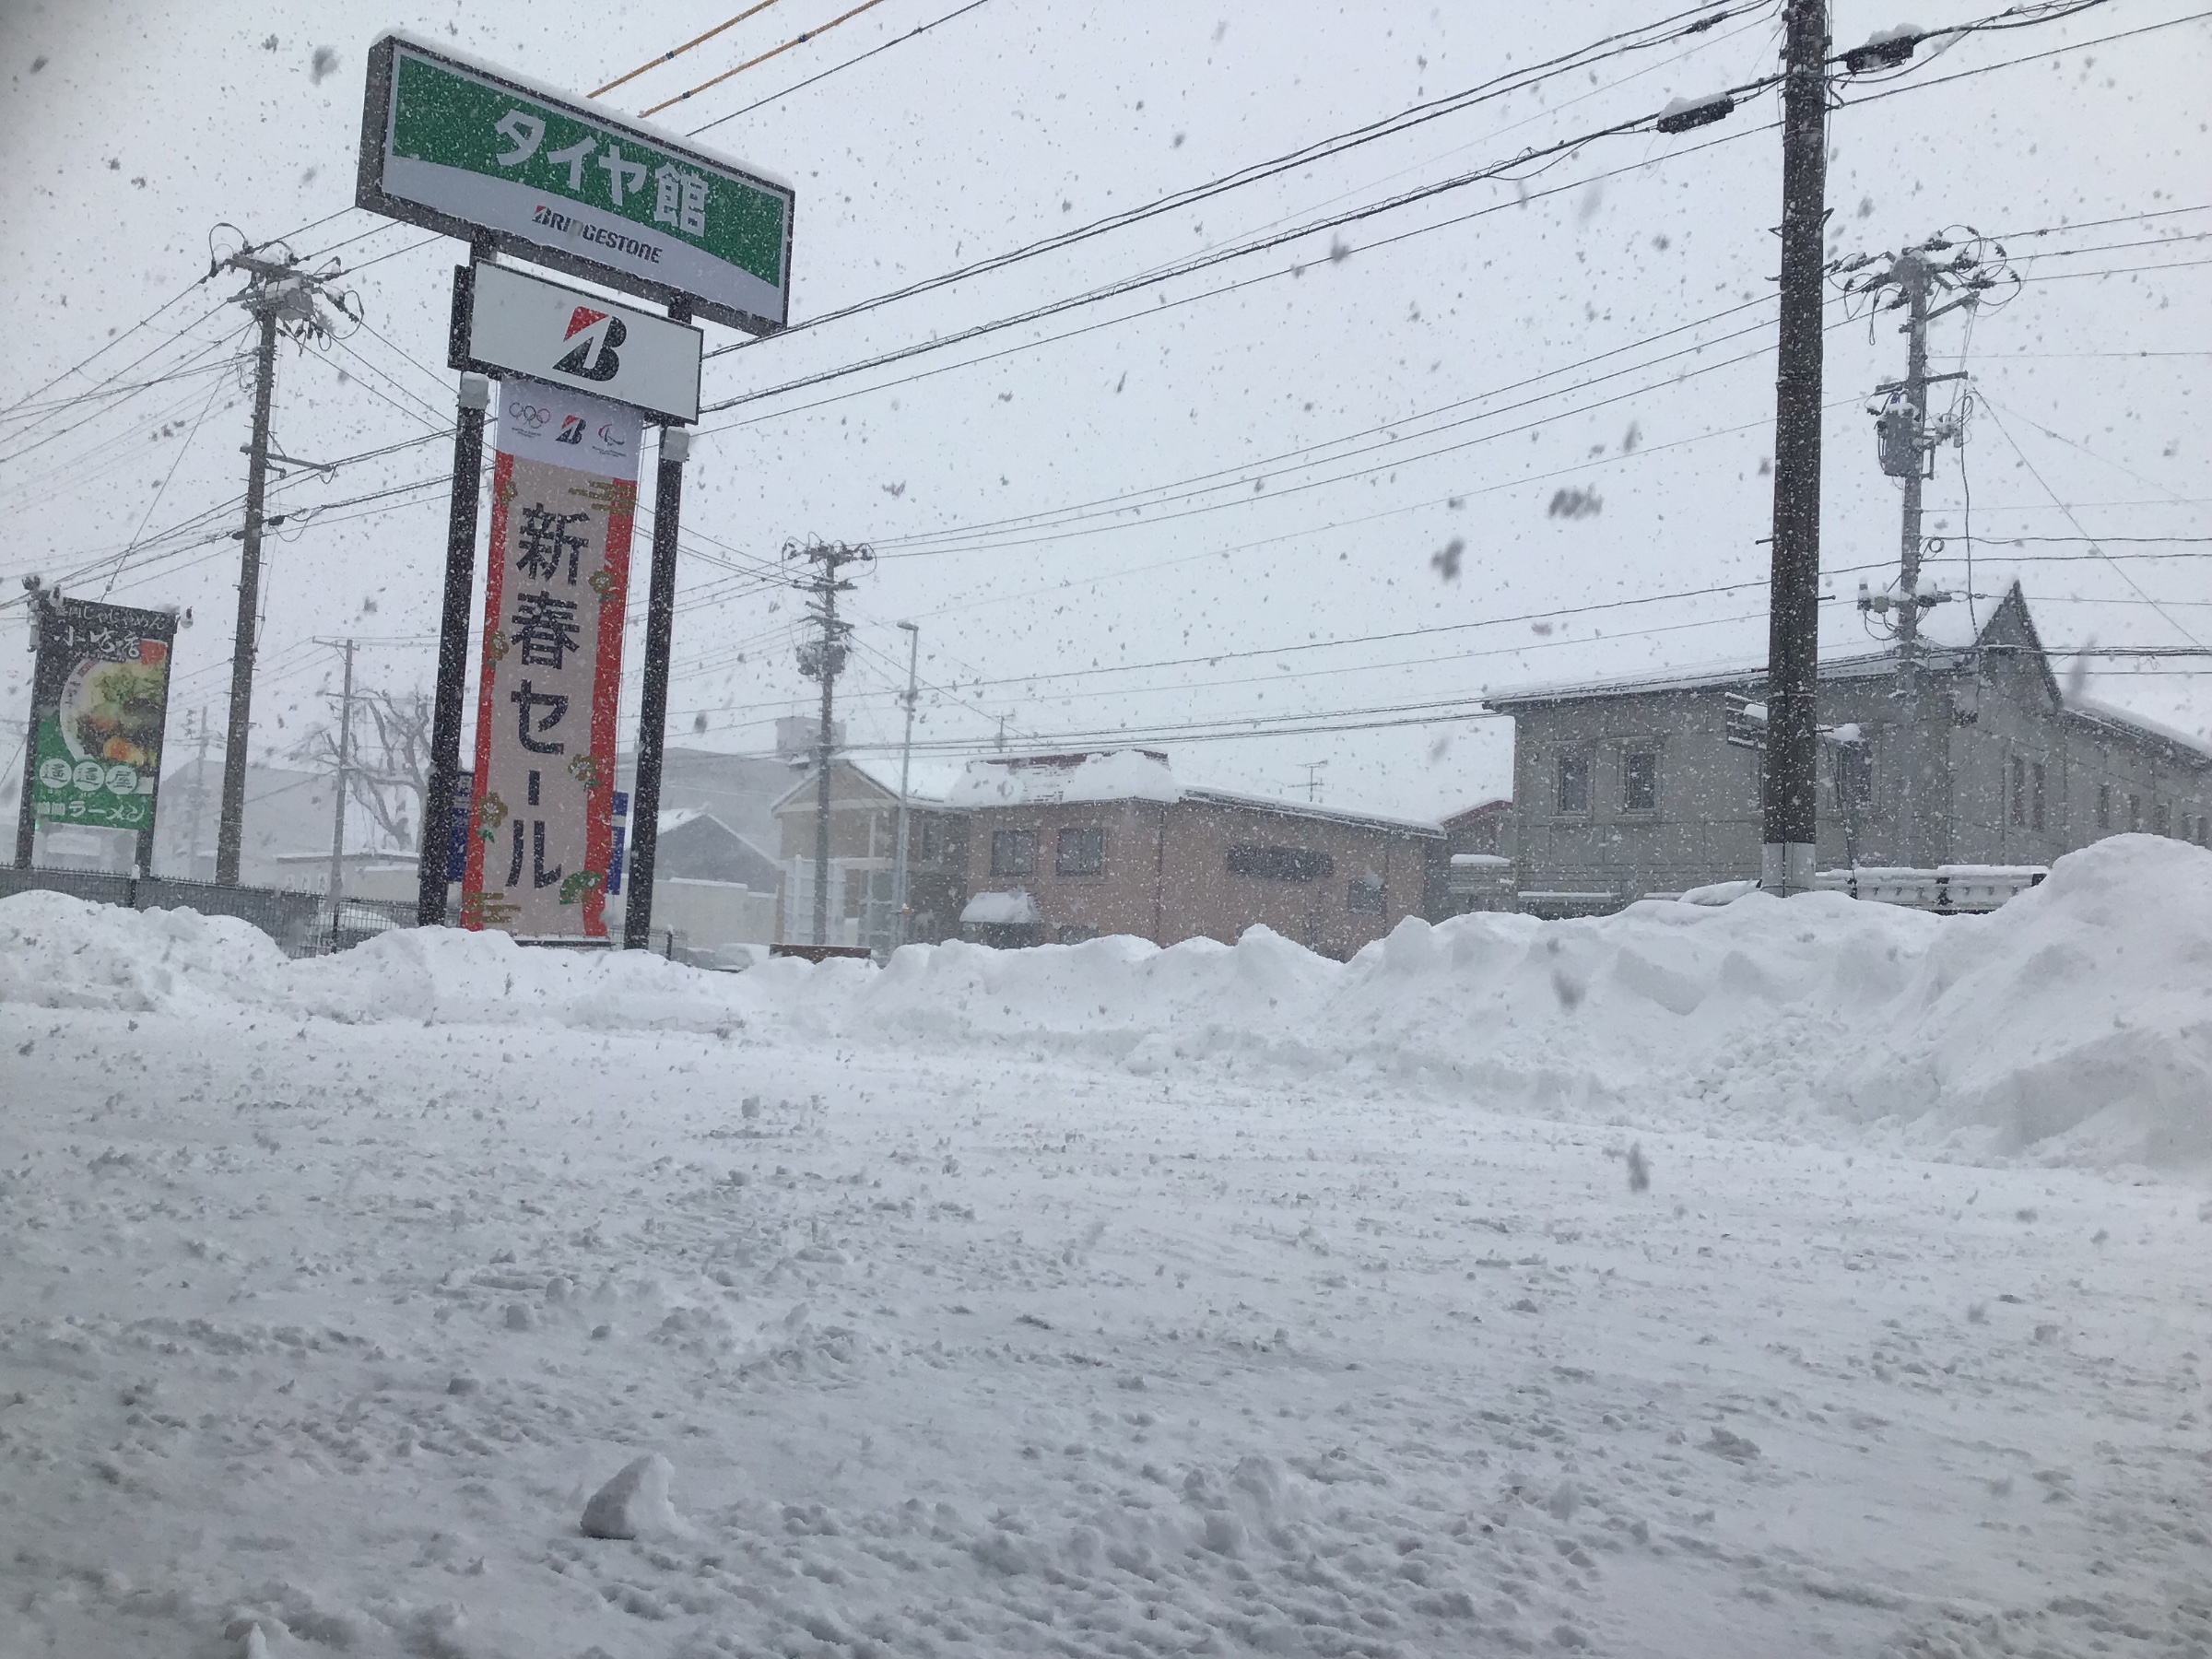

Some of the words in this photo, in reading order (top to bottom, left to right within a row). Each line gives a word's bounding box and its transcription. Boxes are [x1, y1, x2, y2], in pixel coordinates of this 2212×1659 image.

[494, 108, 710, 238] タイヤ館
[506, 501, 591, 889] 新春セール
